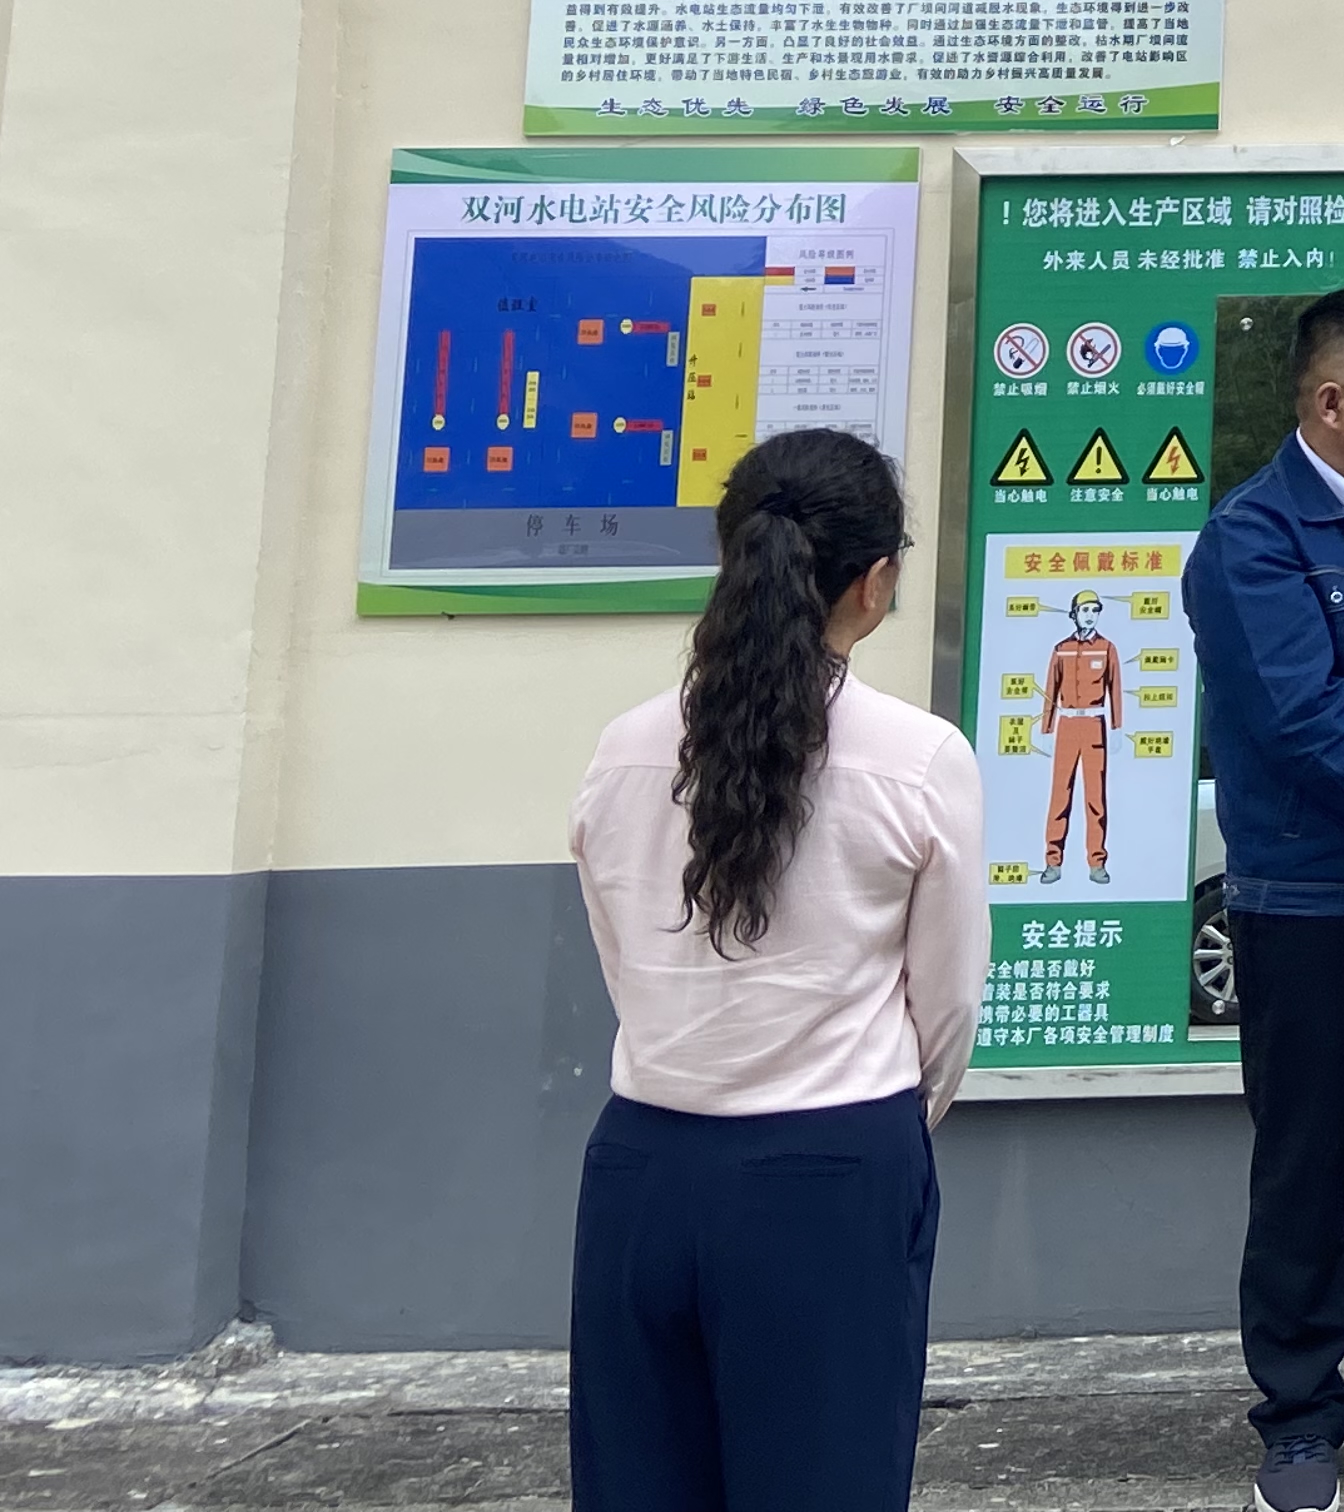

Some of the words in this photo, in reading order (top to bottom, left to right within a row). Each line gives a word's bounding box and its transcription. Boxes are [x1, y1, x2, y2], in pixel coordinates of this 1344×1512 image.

[596, 97, 754, 116] 生态优先
[796, 95, 952, 116] 绿色发展
[995, 95, 1149, 115] 安全运行
[462, 192, 847, 224] 双河水电站安全风险分布图
[1043, 250, 1130, 271] 外来人员
[1138, 249, 1225, 270] 未经批准
[993, 382, 1048, 396] 禁止吸烟
[1067, 381, 1120, 395] 禁止烟火
[994, 489, 1048, 503] 当心触电
[1070, 488, 1124, 502] 注意安全
[1146, 488, 1199, 501] 当心触电
[527, 513, 618, 537] 停车场
[1024, 550, 1164, 573] 安全佩戴标准
[1022, 920, 1123, 949] 安全提示
[976, 1024, 1174, 1047] 遵守本厂各项安全管理制度
